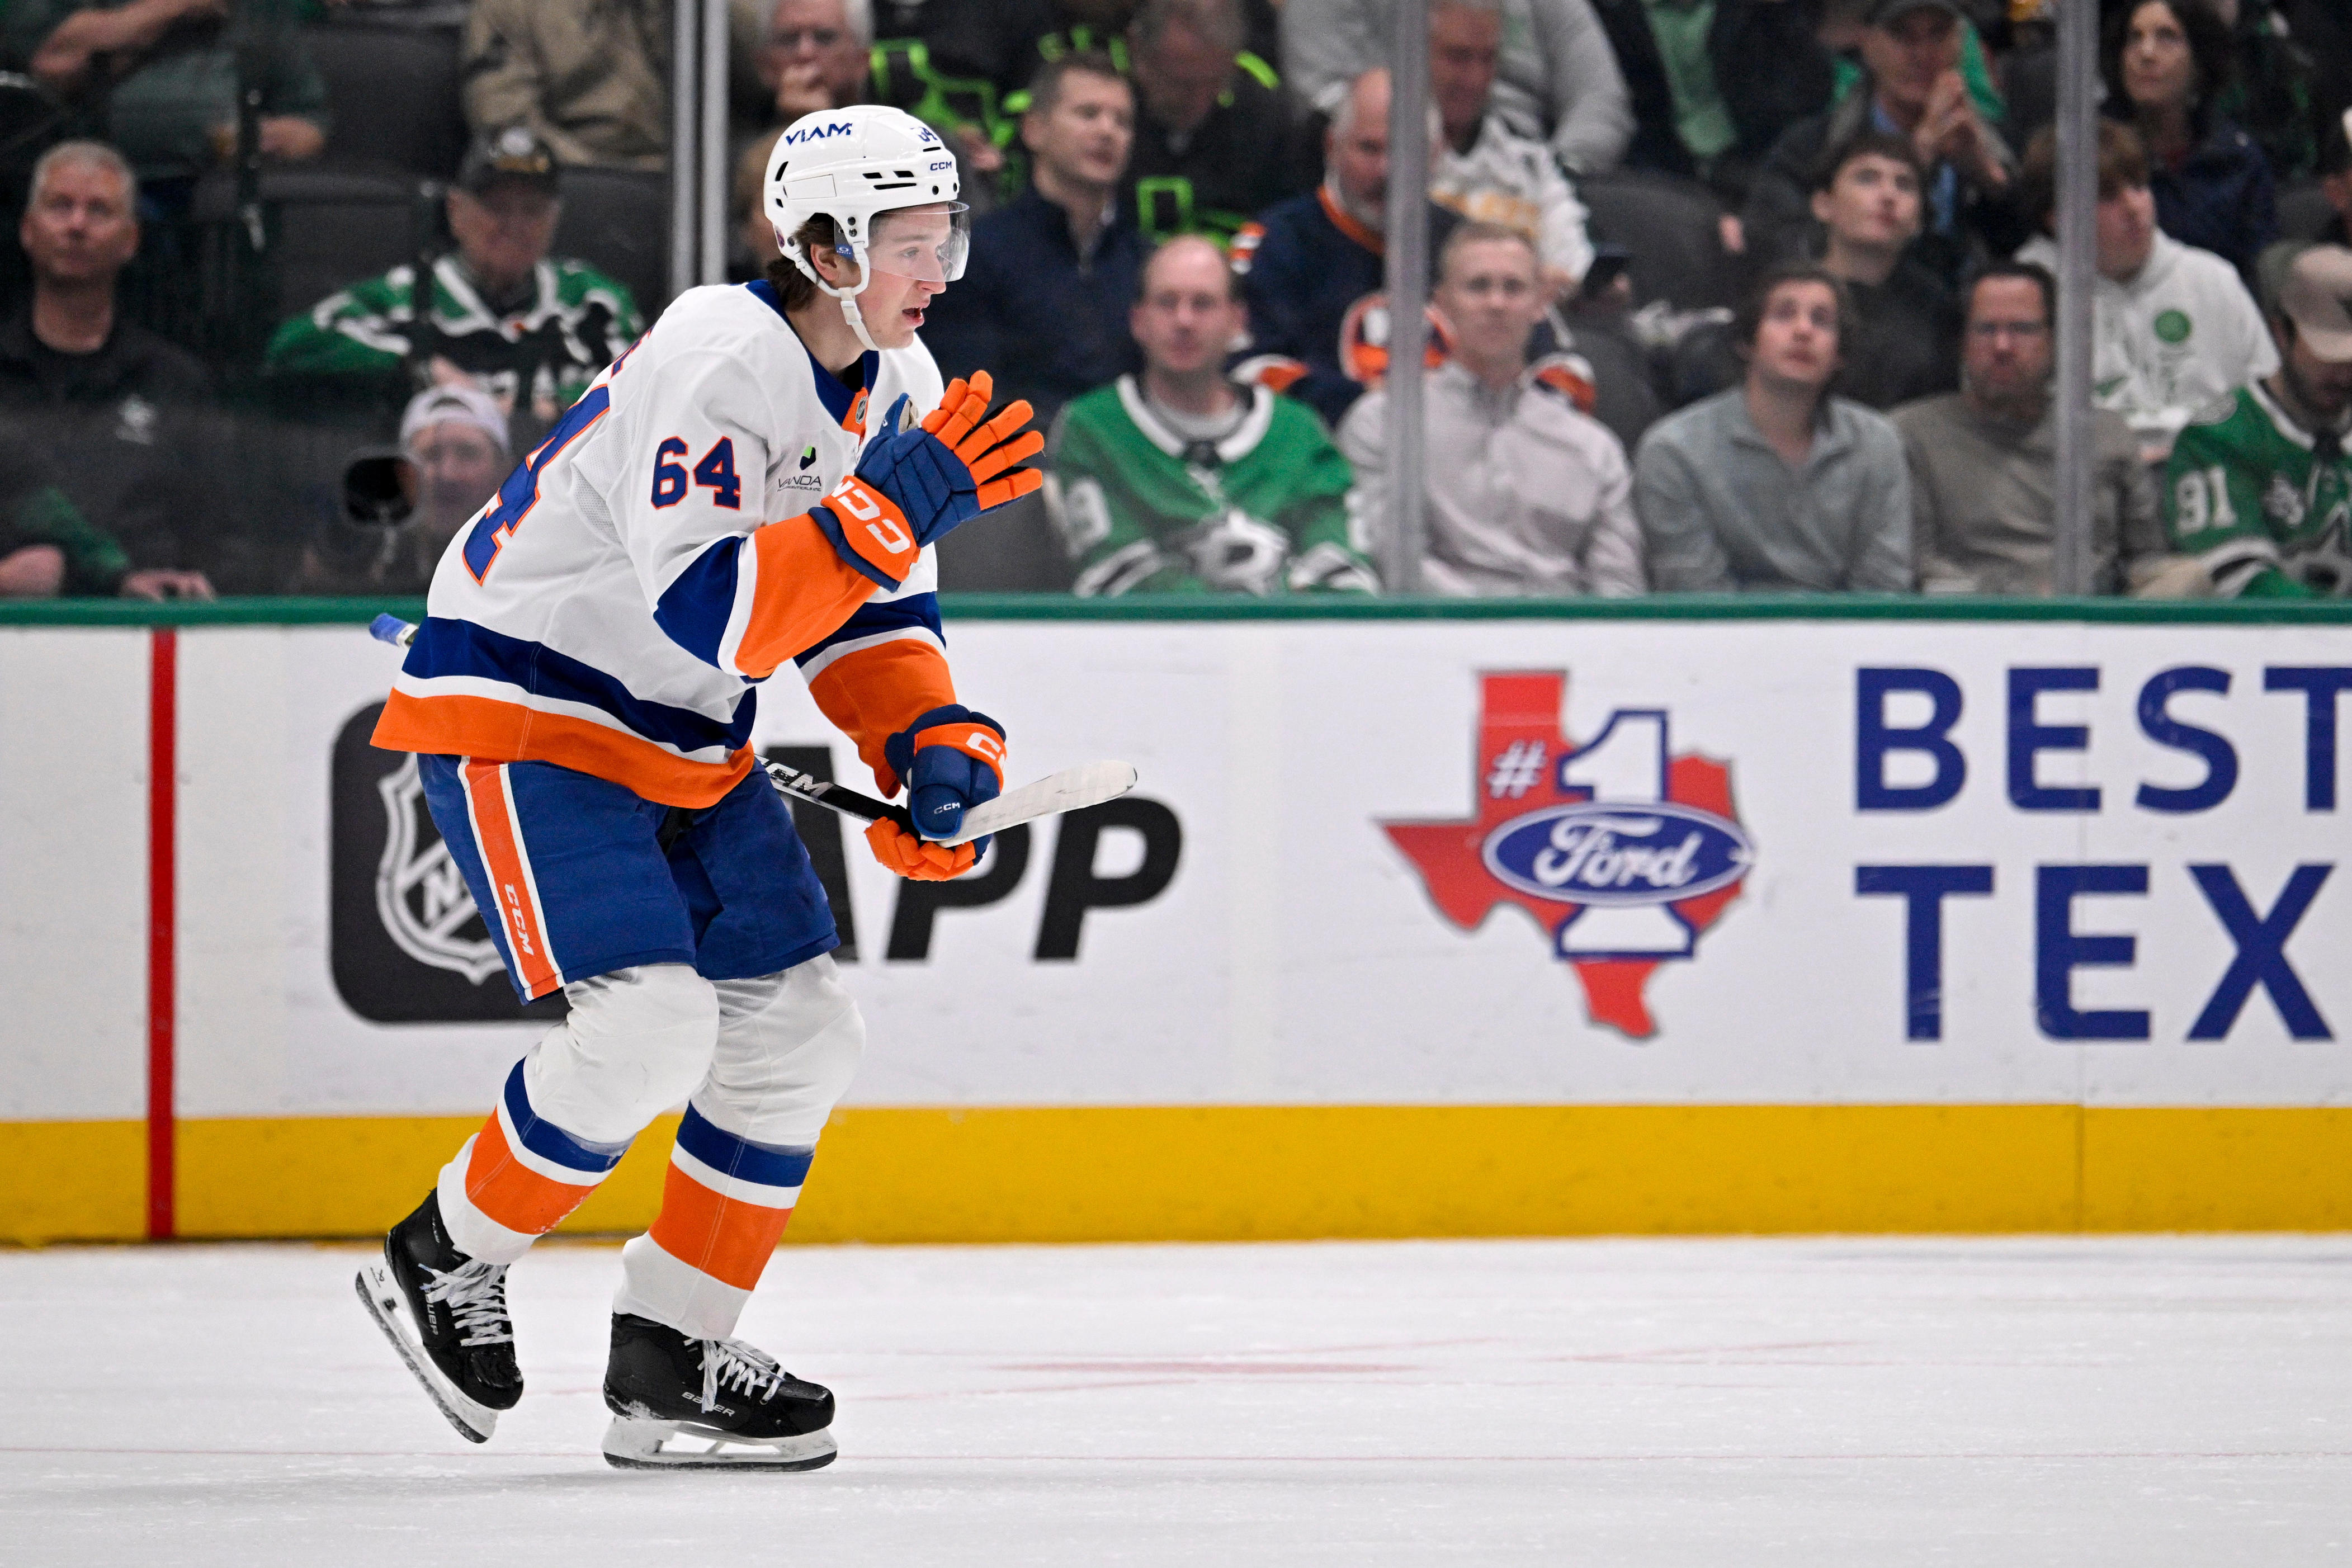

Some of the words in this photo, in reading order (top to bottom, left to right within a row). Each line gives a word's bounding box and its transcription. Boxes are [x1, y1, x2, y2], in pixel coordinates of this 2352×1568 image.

[786, 122, 853, 145] VIAM
[930, 160, 952, 171] CCM
[650, 436, 740, 511] 64
[1854, 665, 2352, 814] BEST
[933, 802, 961, 814] CCM
[1533, 814, 1704, 888] Ford
[504, 882, 534, 956] CCM
[1854, 862, 2337, 1043] TEX
[681, 1391, 735, 1417] BAER
